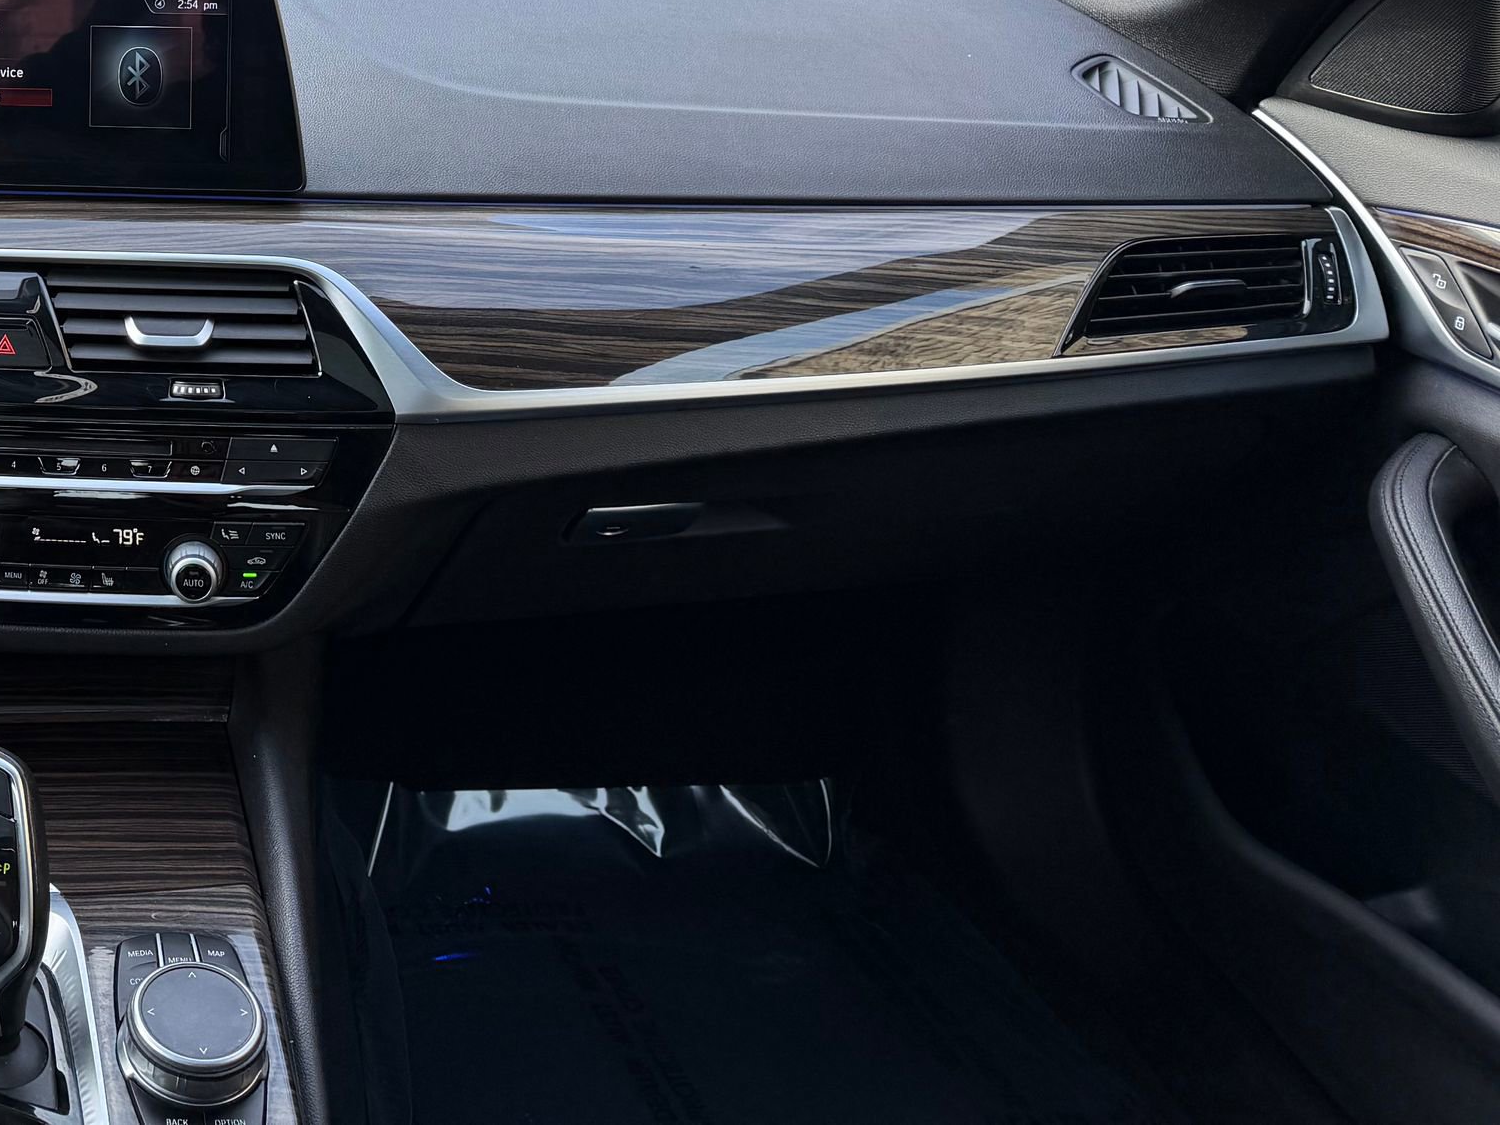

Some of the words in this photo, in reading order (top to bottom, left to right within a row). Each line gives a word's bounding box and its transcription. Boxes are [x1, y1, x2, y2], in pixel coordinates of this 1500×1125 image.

[177, 0, 198, 10] 2:54
[203, 2, 218, 11] pm
[11, 460, 16, 468] 4
[56, 463, 62, 471] 5
[101, 463, 107, 472] 6
[147, 465, 153, 473] 7
[265, 532, 286, 540] SYNC
[4, 571, 22, 579] MENU
[183, 579, 204, 587] AUTO
[3, 863, 11, 874] P
[127, 949, 154, 958] MEDIA
